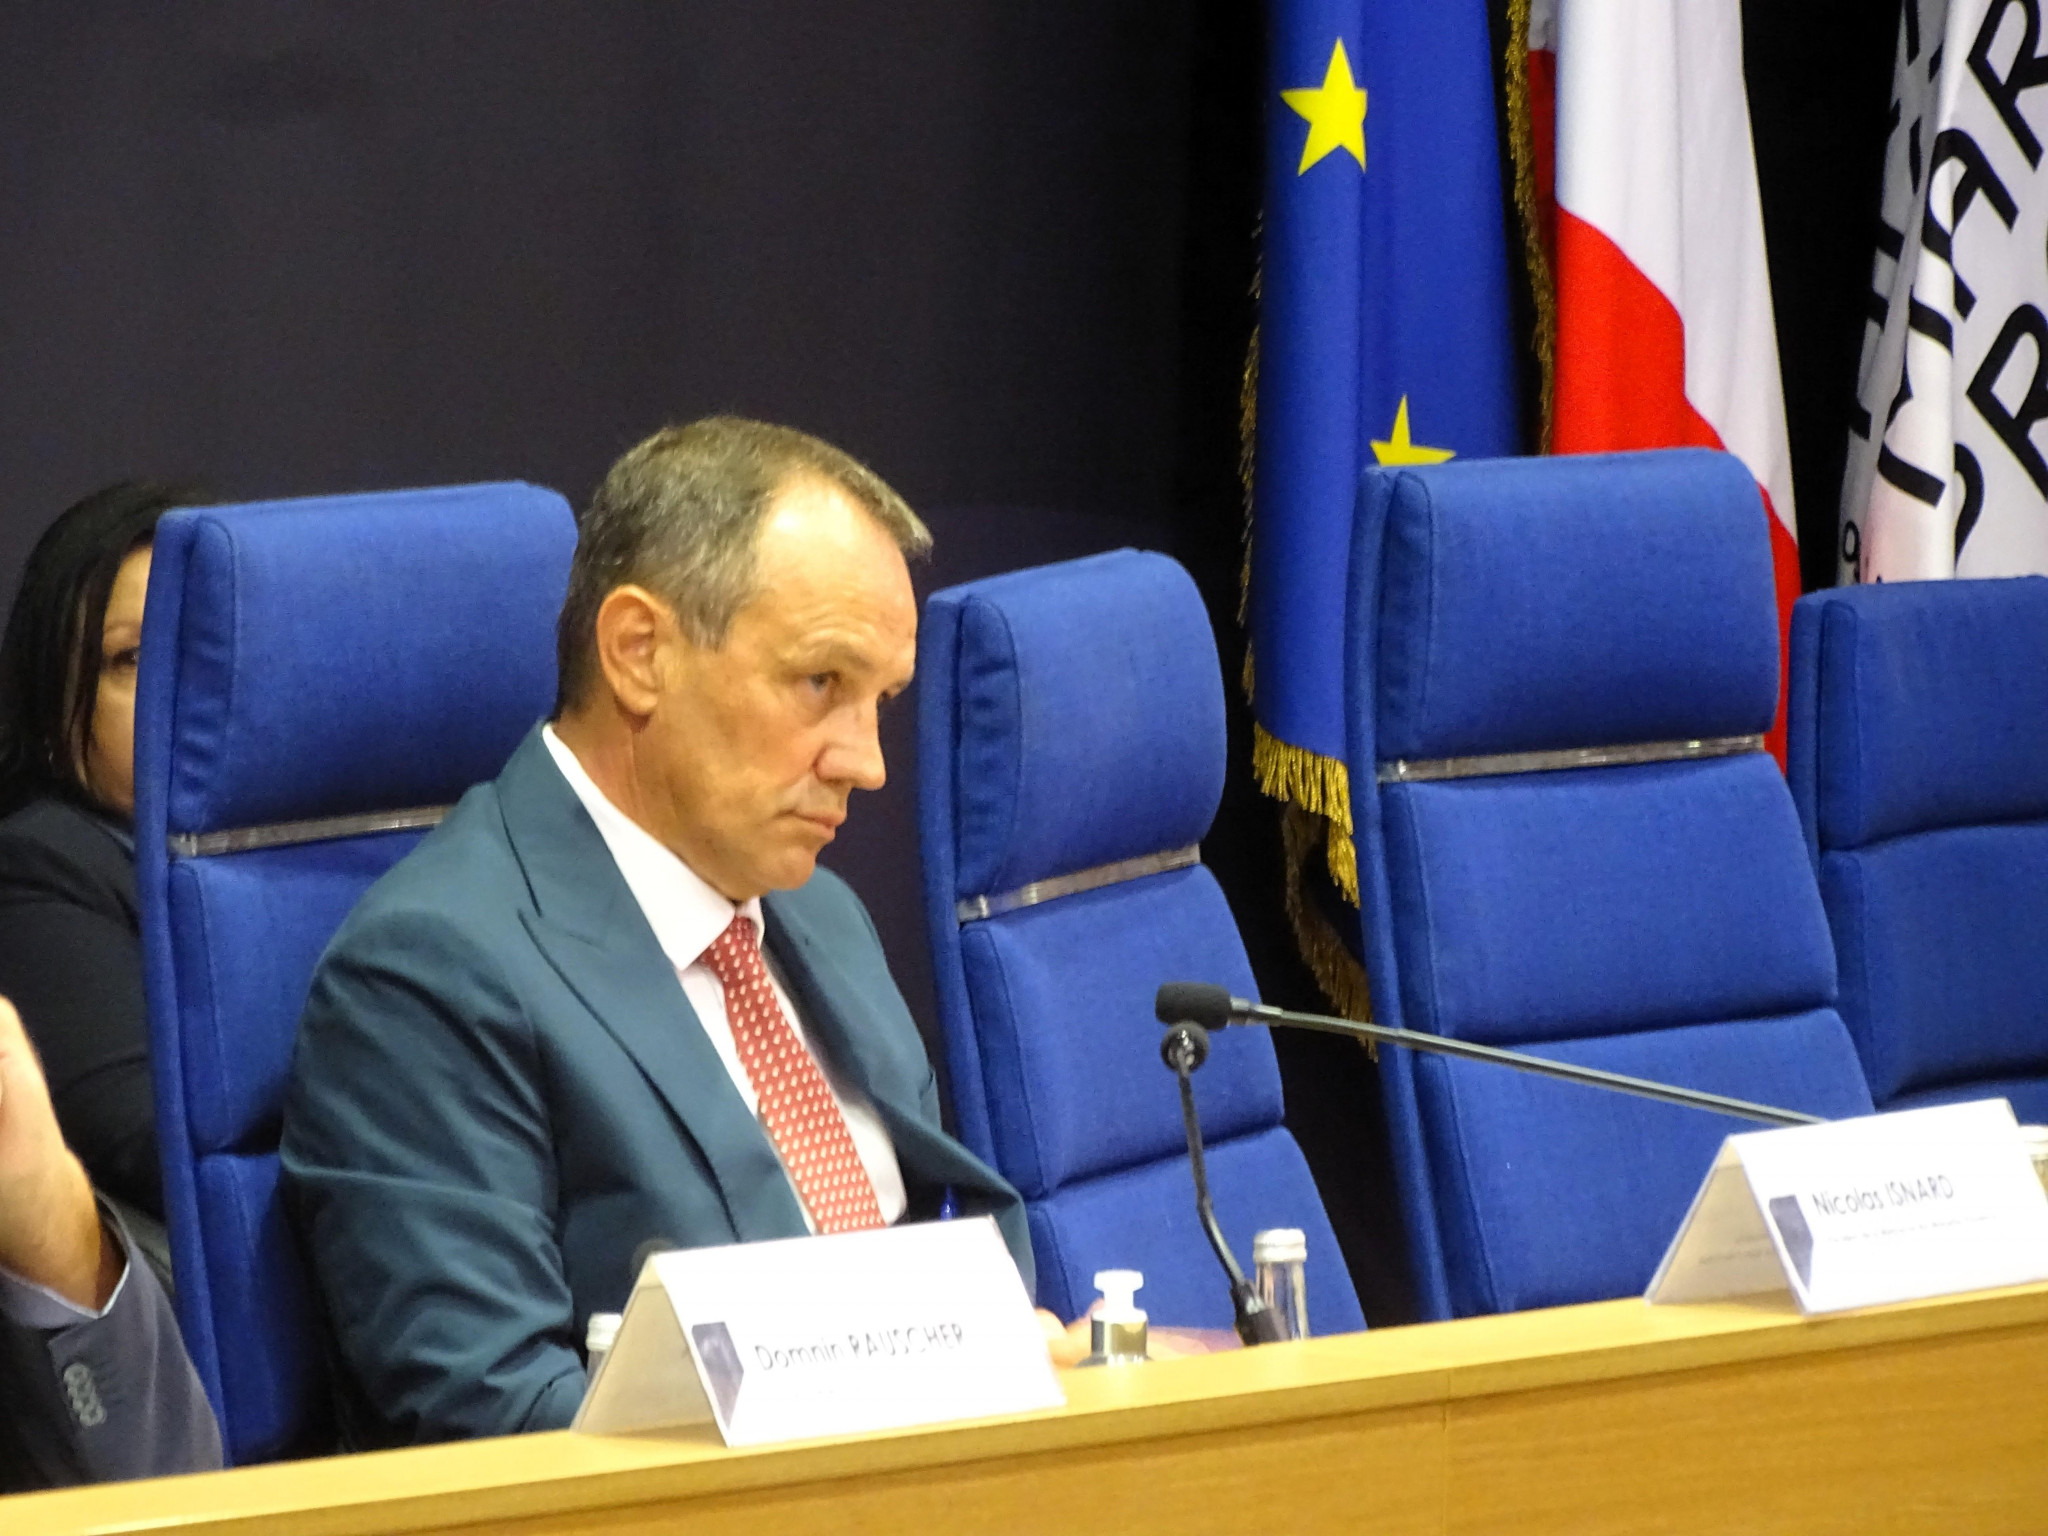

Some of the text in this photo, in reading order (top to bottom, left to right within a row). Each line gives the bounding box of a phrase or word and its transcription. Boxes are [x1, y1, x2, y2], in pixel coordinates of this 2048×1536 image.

[1812, 1174, 1954, 1215] Nicolas ISNARD
[754, 1339, 843, 1371] Domnin
